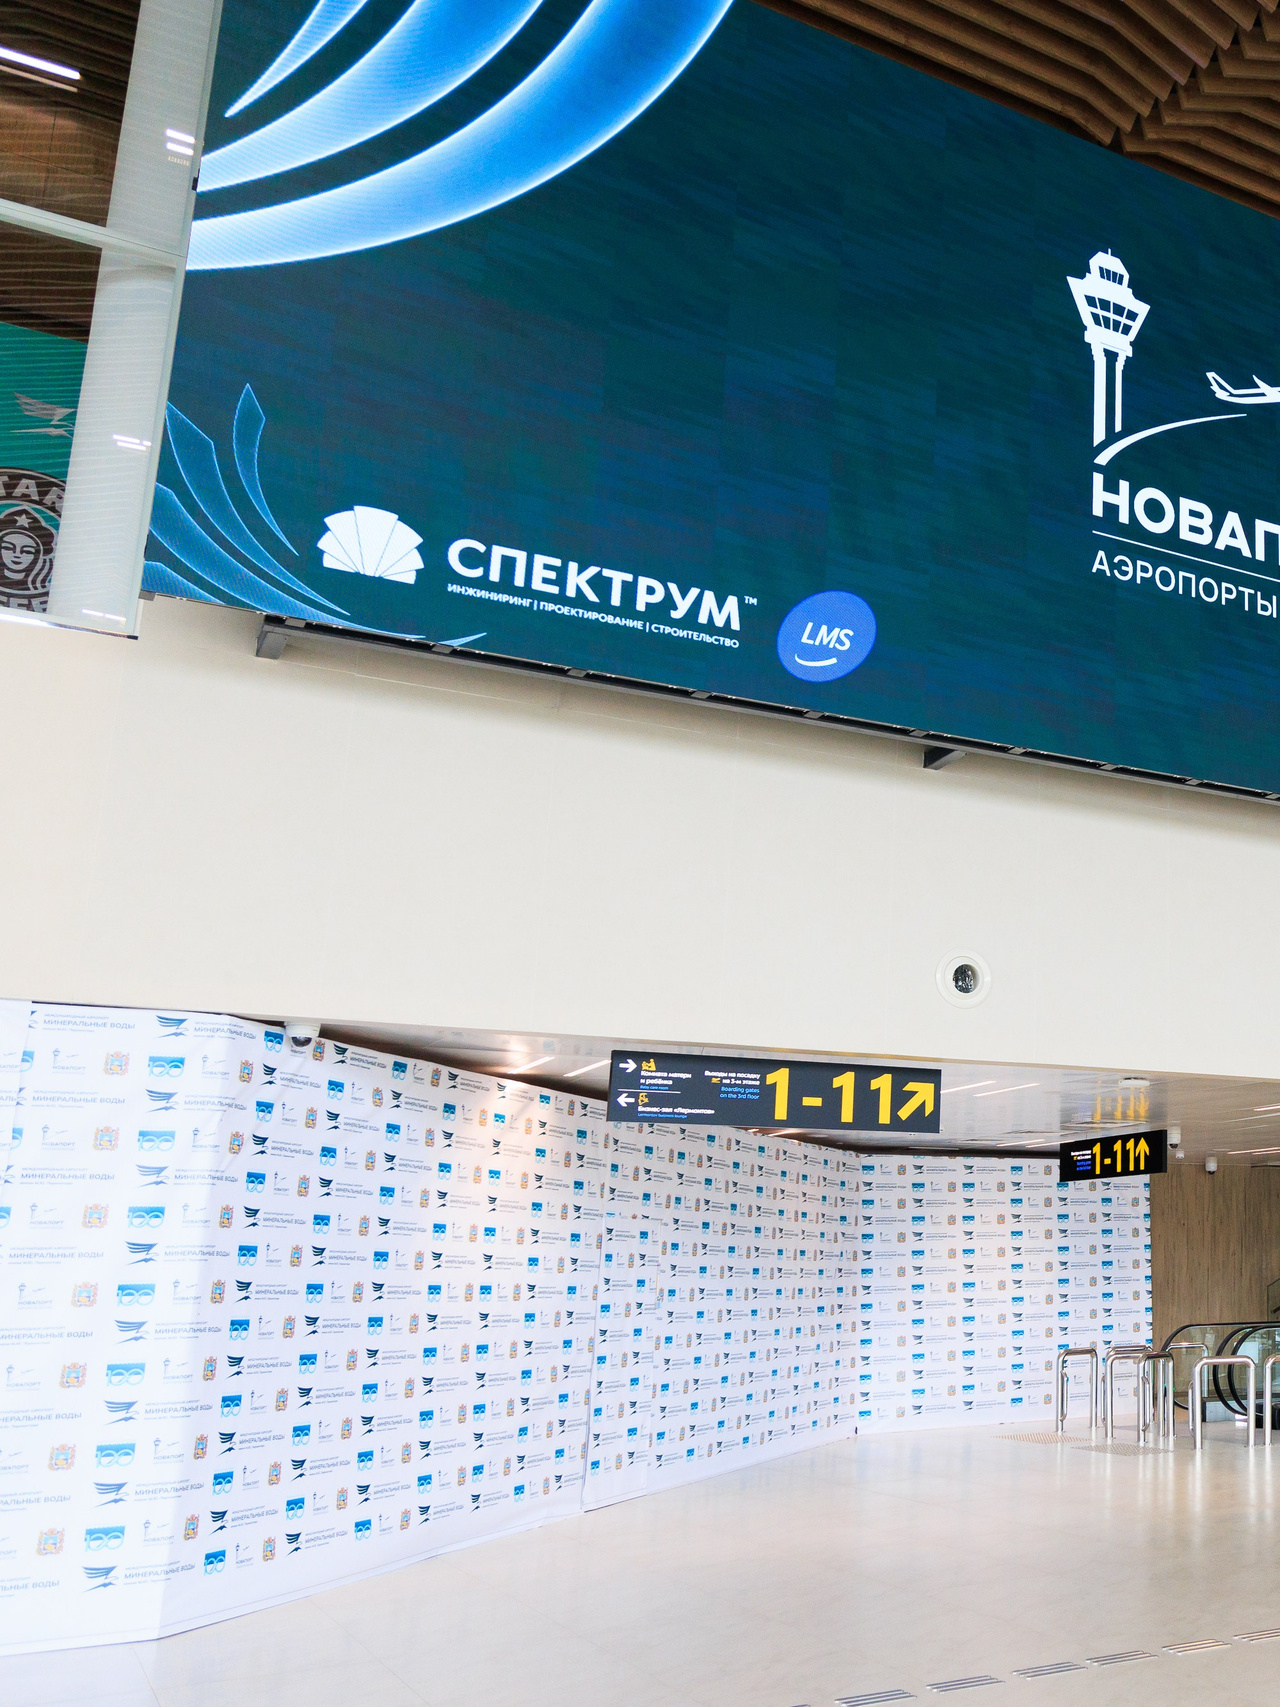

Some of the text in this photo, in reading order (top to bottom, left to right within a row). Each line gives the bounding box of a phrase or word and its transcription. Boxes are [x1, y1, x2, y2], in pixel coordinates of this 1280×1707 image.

[447, 538, 741, 631] СПЕКТРУМ
[1091, 549, 1277, 619] АЭРОПОРТЫ
[447, 583, 740, 649] ИНЖИНИРИНГ ПРОЕКТИРОВАНИЕ СТРОИТЕЛЬСТВО
[800, 621, 854, 651] LMS
[44, 1019, 108, 1028] МИНЕРАЛЬНЫЕ
[194, 1027, 256, 1040] МИНЕРАЛЬНЫЕ ВОДЫ
[184, 1100, 233, 1109] МИНЕРАЛЬНЫЕ
[0, 1332, 65, 1340] МИНЕРАЛЬНЫЕ
[144, 1404, 213, 1414] МИНЕРАЛЬНЫЕ ВОДЫ
[135, 1486, 188, 1495] МИНЕРАЛЬНЫЕ
[124, 1563, 195, 1579] МИНЕРАЛЬНЫЕ ВОДЫ
